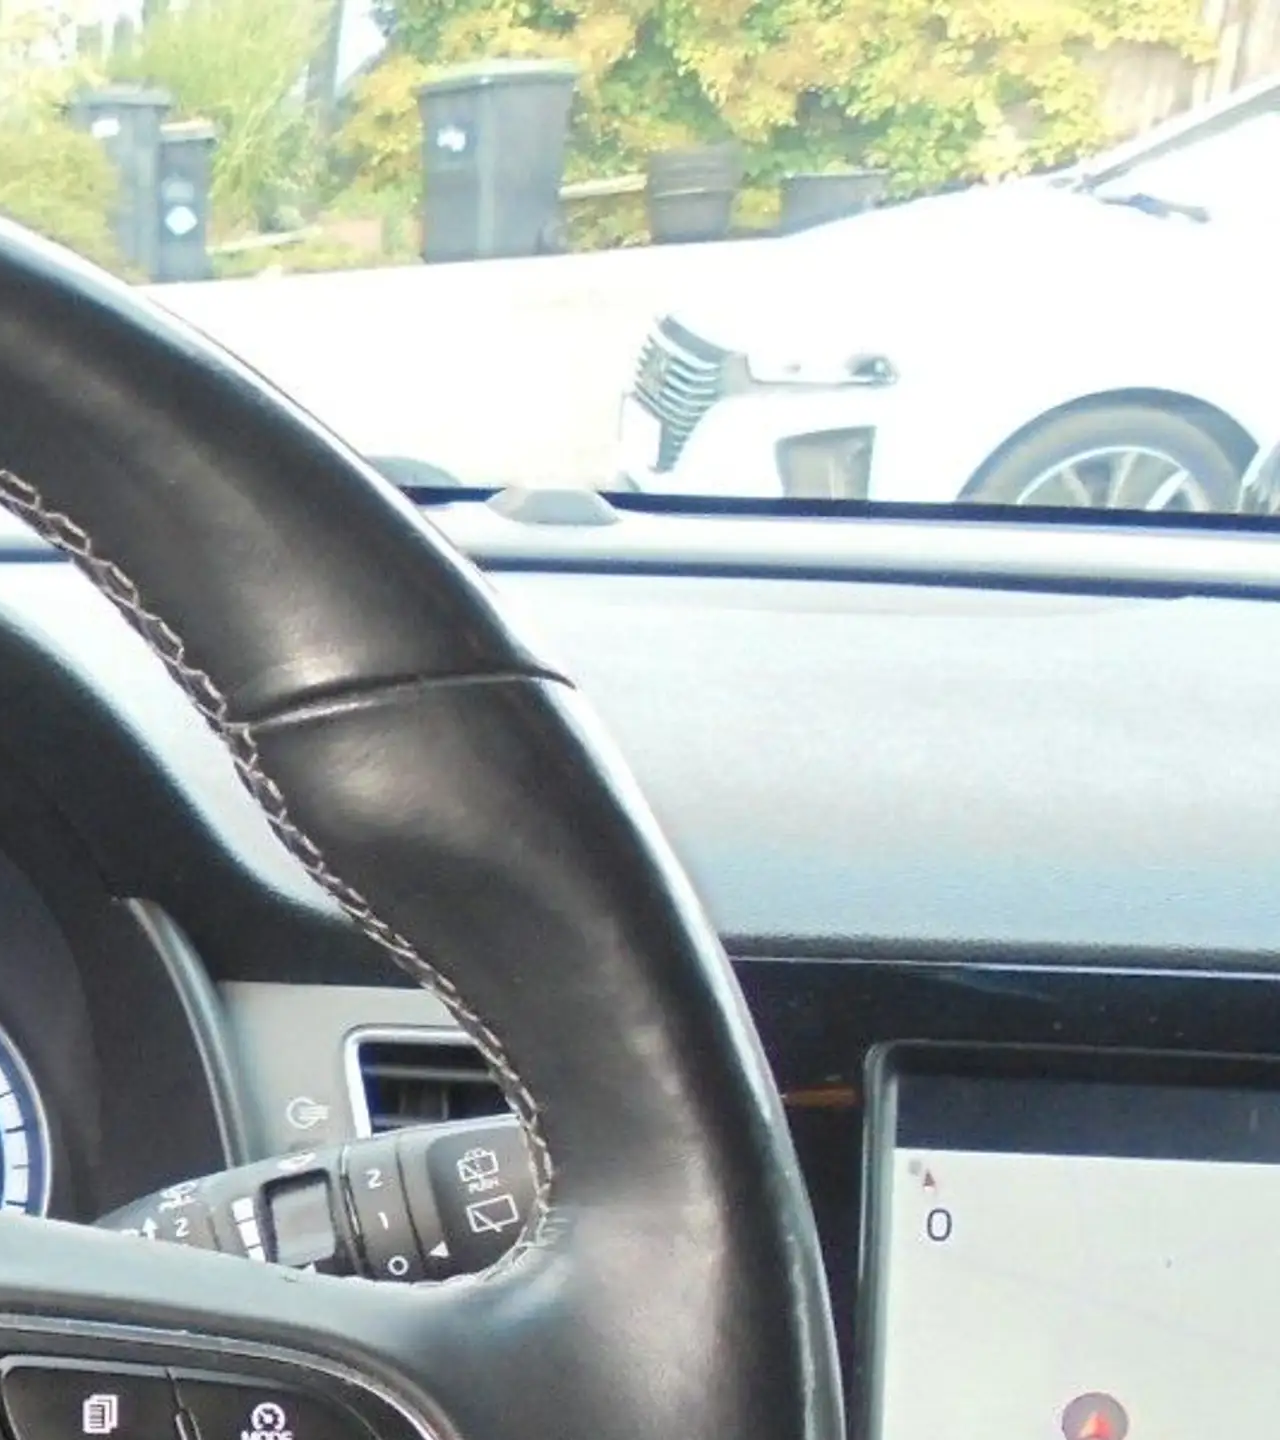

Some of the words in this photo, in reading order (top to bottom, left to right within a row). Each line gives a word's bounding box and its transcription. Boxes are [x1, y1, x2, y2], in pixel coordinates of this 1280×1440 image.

[366, 1168, 383, 1189] 2
[174, 1217, 190, 1238] 2
[926, 1208, 953, 1242] 0
